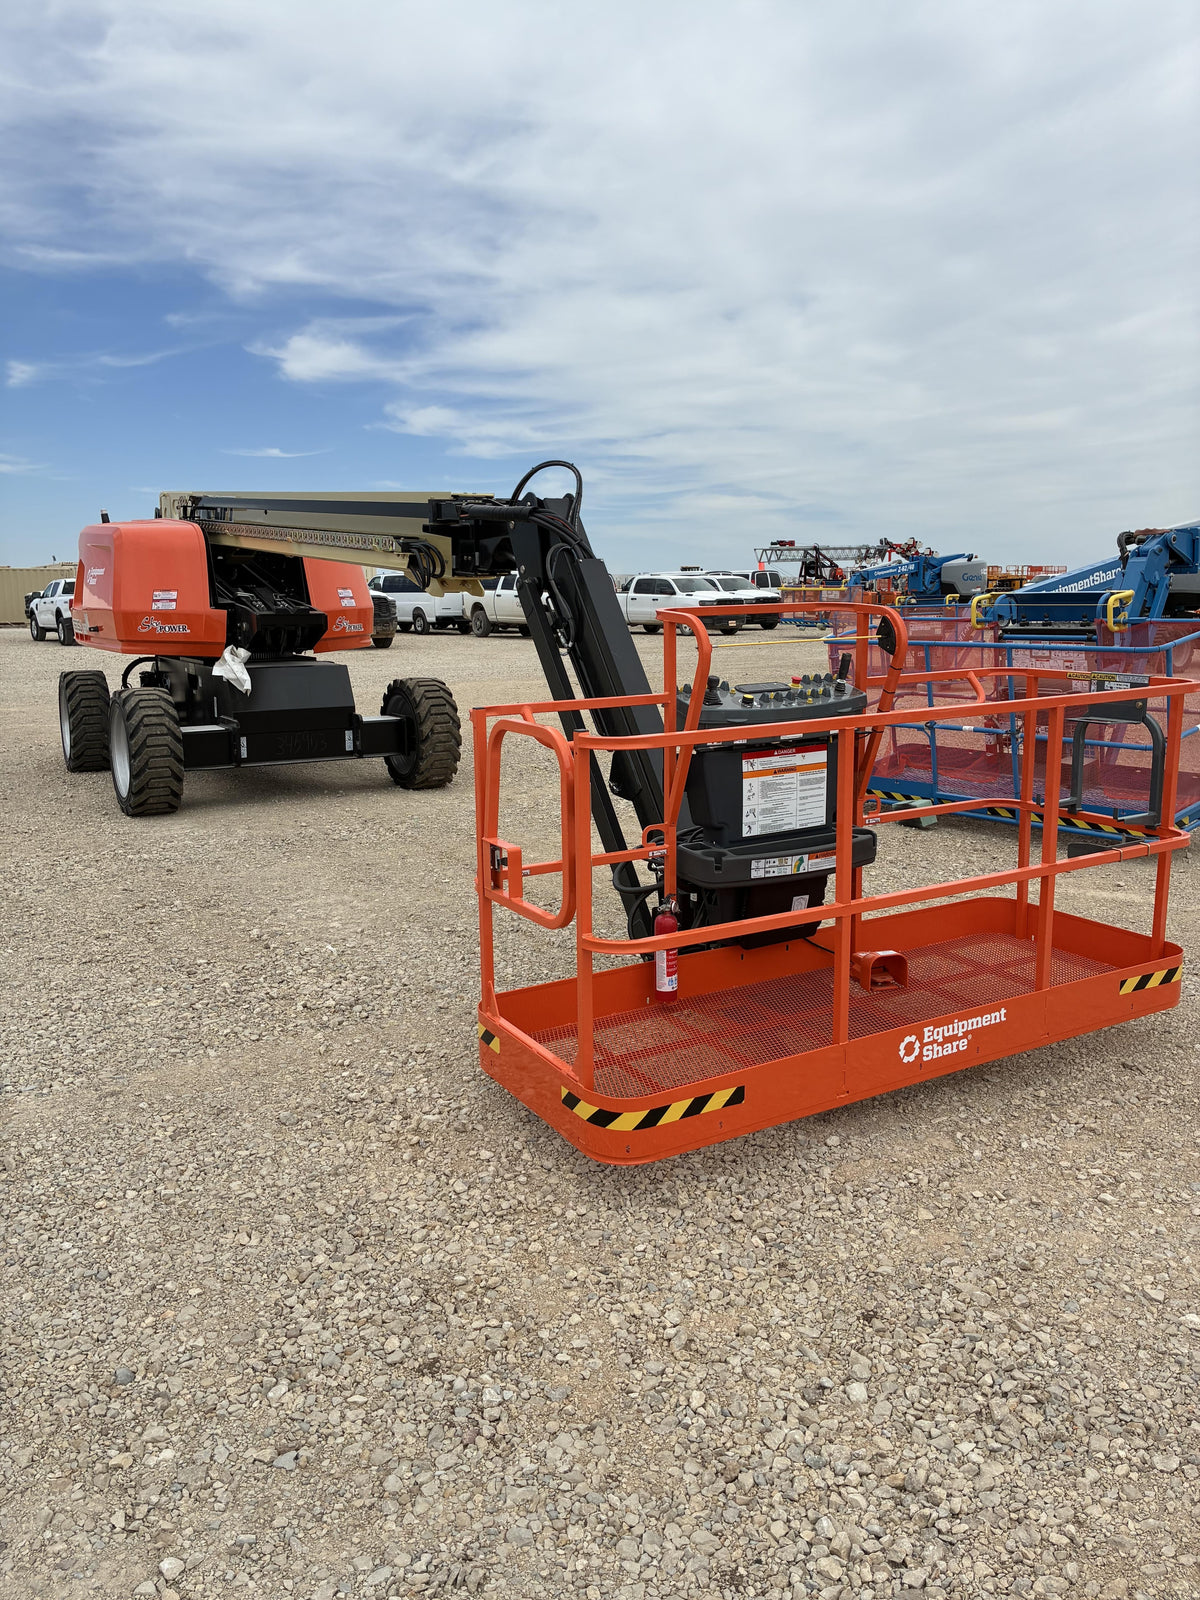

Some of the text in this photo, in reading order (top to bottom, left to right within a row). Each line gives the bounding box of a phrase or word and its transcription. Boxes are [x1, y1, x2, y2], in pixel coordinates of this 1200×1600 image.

[962, 572, 983, 582] Genie
[1042, 567, 1121, 593] imentShar
[1095, 673, 1116, 681] CAUTION
[923, 1008, 1007, 1043] Equipment
